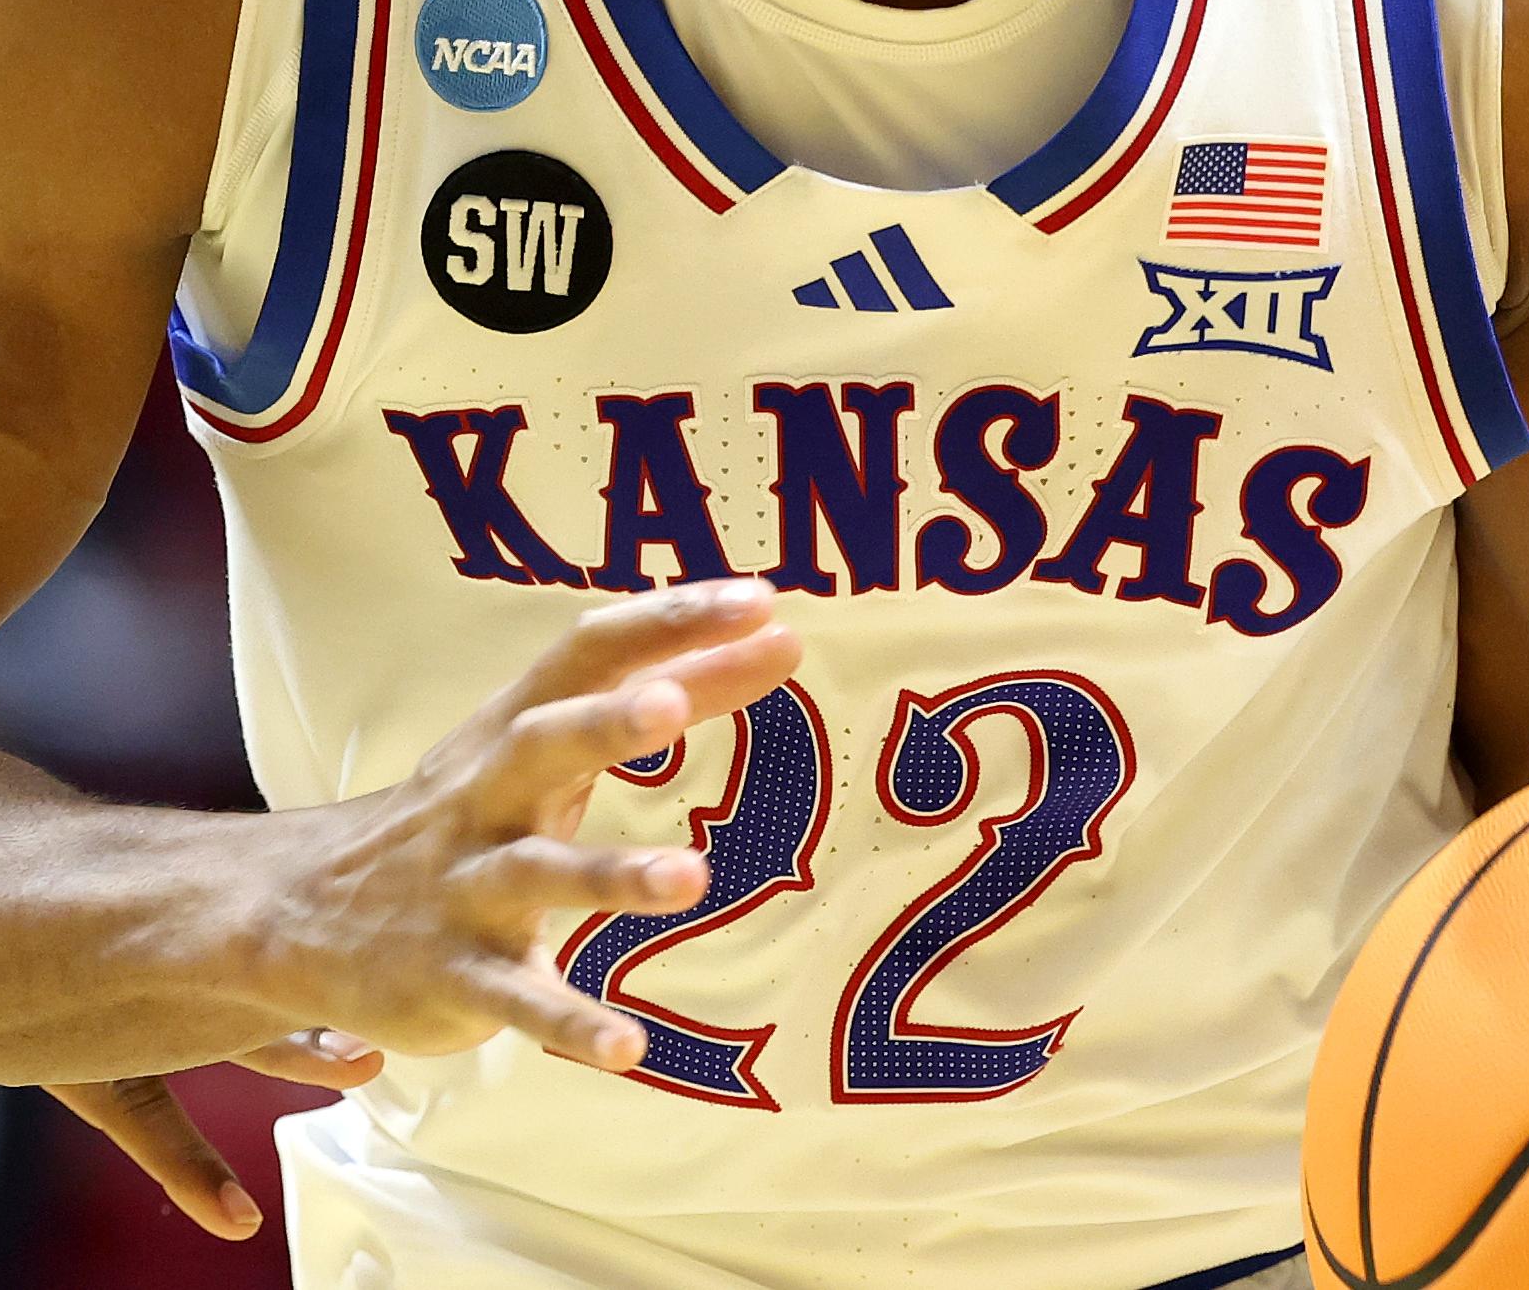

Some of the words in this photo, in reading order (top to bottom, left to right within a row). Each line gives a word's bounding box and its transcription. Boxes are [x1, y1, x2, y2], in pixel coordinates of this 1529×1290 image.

[431, 37, 537, 78] NCAA
[446, 194, 585, 297] SW
[1131, 258, 1342, 373] XII
[381, 381, 1372, 638] KANSAS
[543, 669, 1137, 1112] 22
